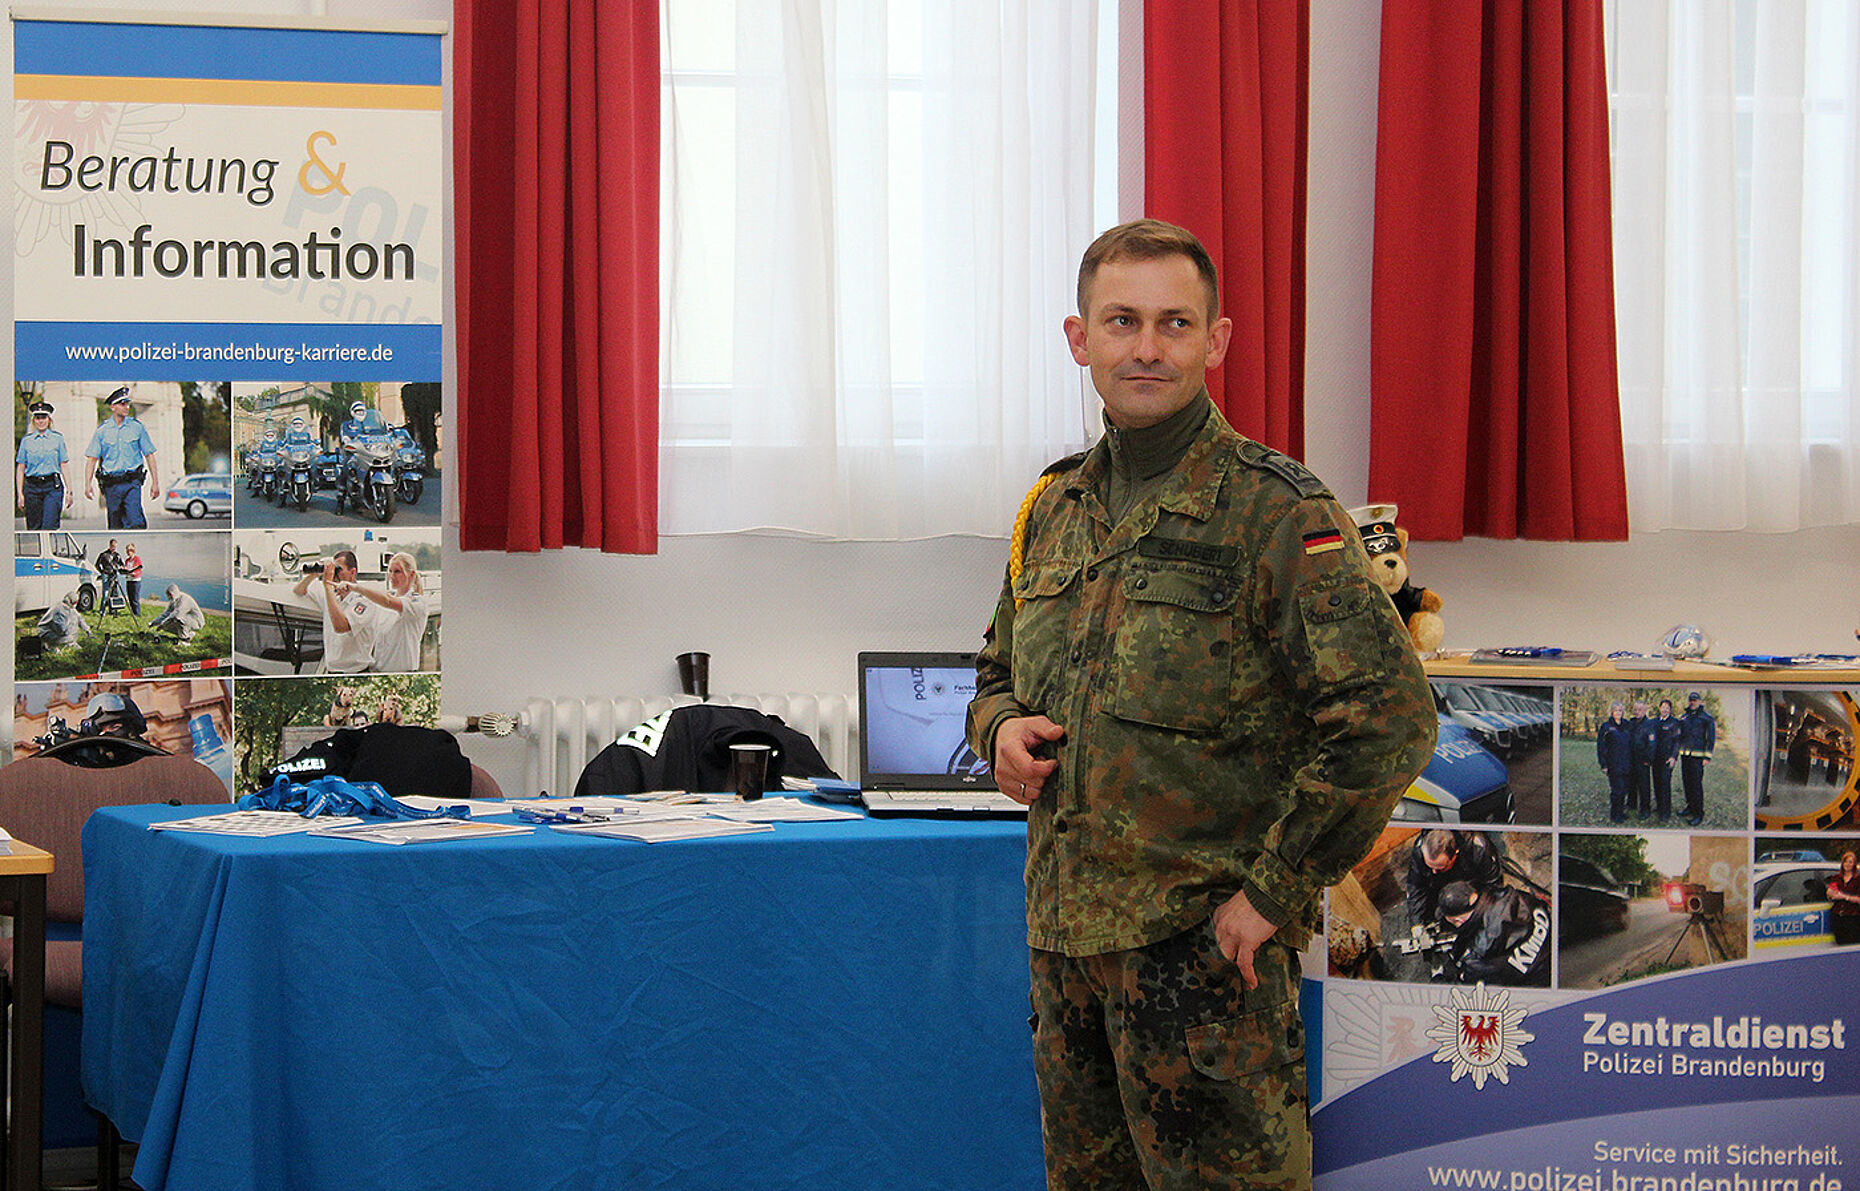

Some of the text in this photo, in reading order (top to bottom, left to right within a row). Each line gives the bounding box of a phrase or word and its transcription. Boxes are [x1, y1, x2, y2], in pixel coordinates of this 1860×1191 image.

[40, 131, 351, 206] Beratung &
[73, 225, 415, 281] Information
[65, 343, 393, 365] www.polizei-brandenburg-karriere.de
[1754, 919, 1804, 936] POLIZEI
[1583, 1013, 1845, 1049] Zentraldienst
[1584, 1052, 1825, 1083] Polizei Brandenburg
[1593, 1140, 1843, 1166] Service mit Sicherheit.
